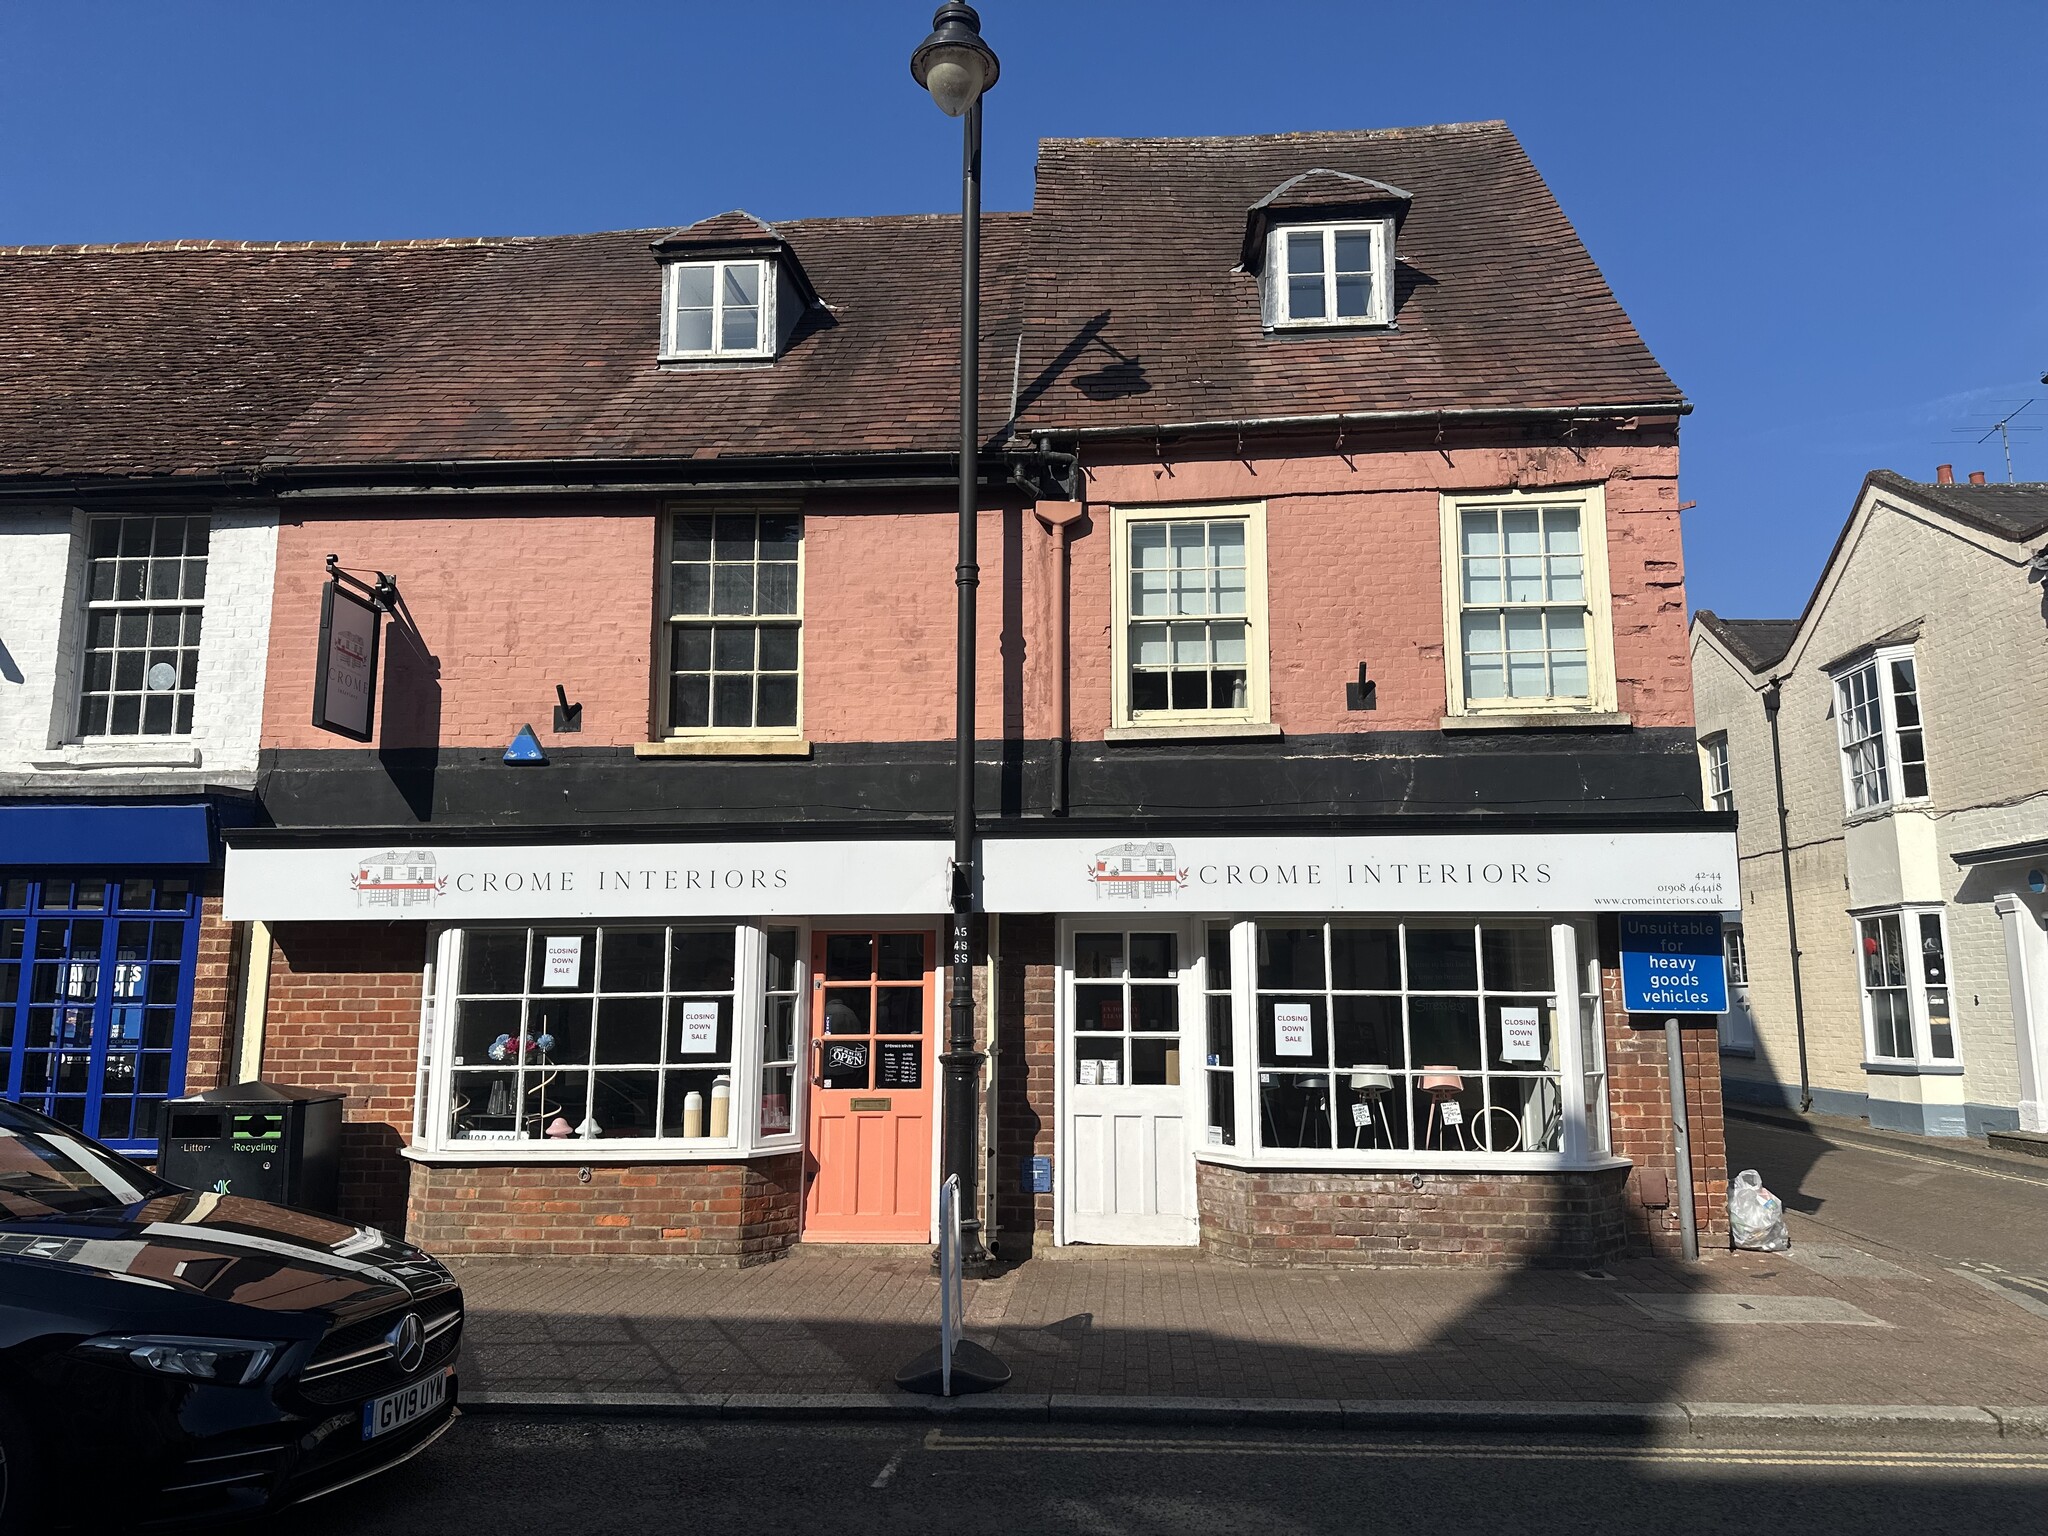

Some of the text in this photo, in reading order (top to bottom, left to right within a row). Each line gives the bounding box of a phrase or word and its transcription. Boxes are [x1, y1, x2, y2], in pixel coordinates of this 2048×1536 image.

[329, 668, 368, 695] CROME
[457, 869, 788, 893] CROME INTERIORS
[1199, 863, 1552, 885] CROME INTERIORS
[1695, 872, 1721, 881] 42-44
[1657, 881, 1723, 894] 01908 464418
[1593, 894, 1723, 906] www.cromeinteriors.co.uk
[954, 926, 968, 937] A5
[1628, 921, 1714, 935] Unsuitable
[1660, 938, 1684, 952] for
[1650, 955, 1697, 972] heavy
[1650, 973, 1699, 989] goods
[1643, 990, 1709, 1003] vehicles
[1414, 999, 1466, 1013] Stressless
[1504, 1018, 1537, 1026] CLOSING
[833, 1051, 862, 1066] OPEN
[184, 1143, 278, 1154] Litter Recycling
[381, 1388, 418, 1428] GV19
